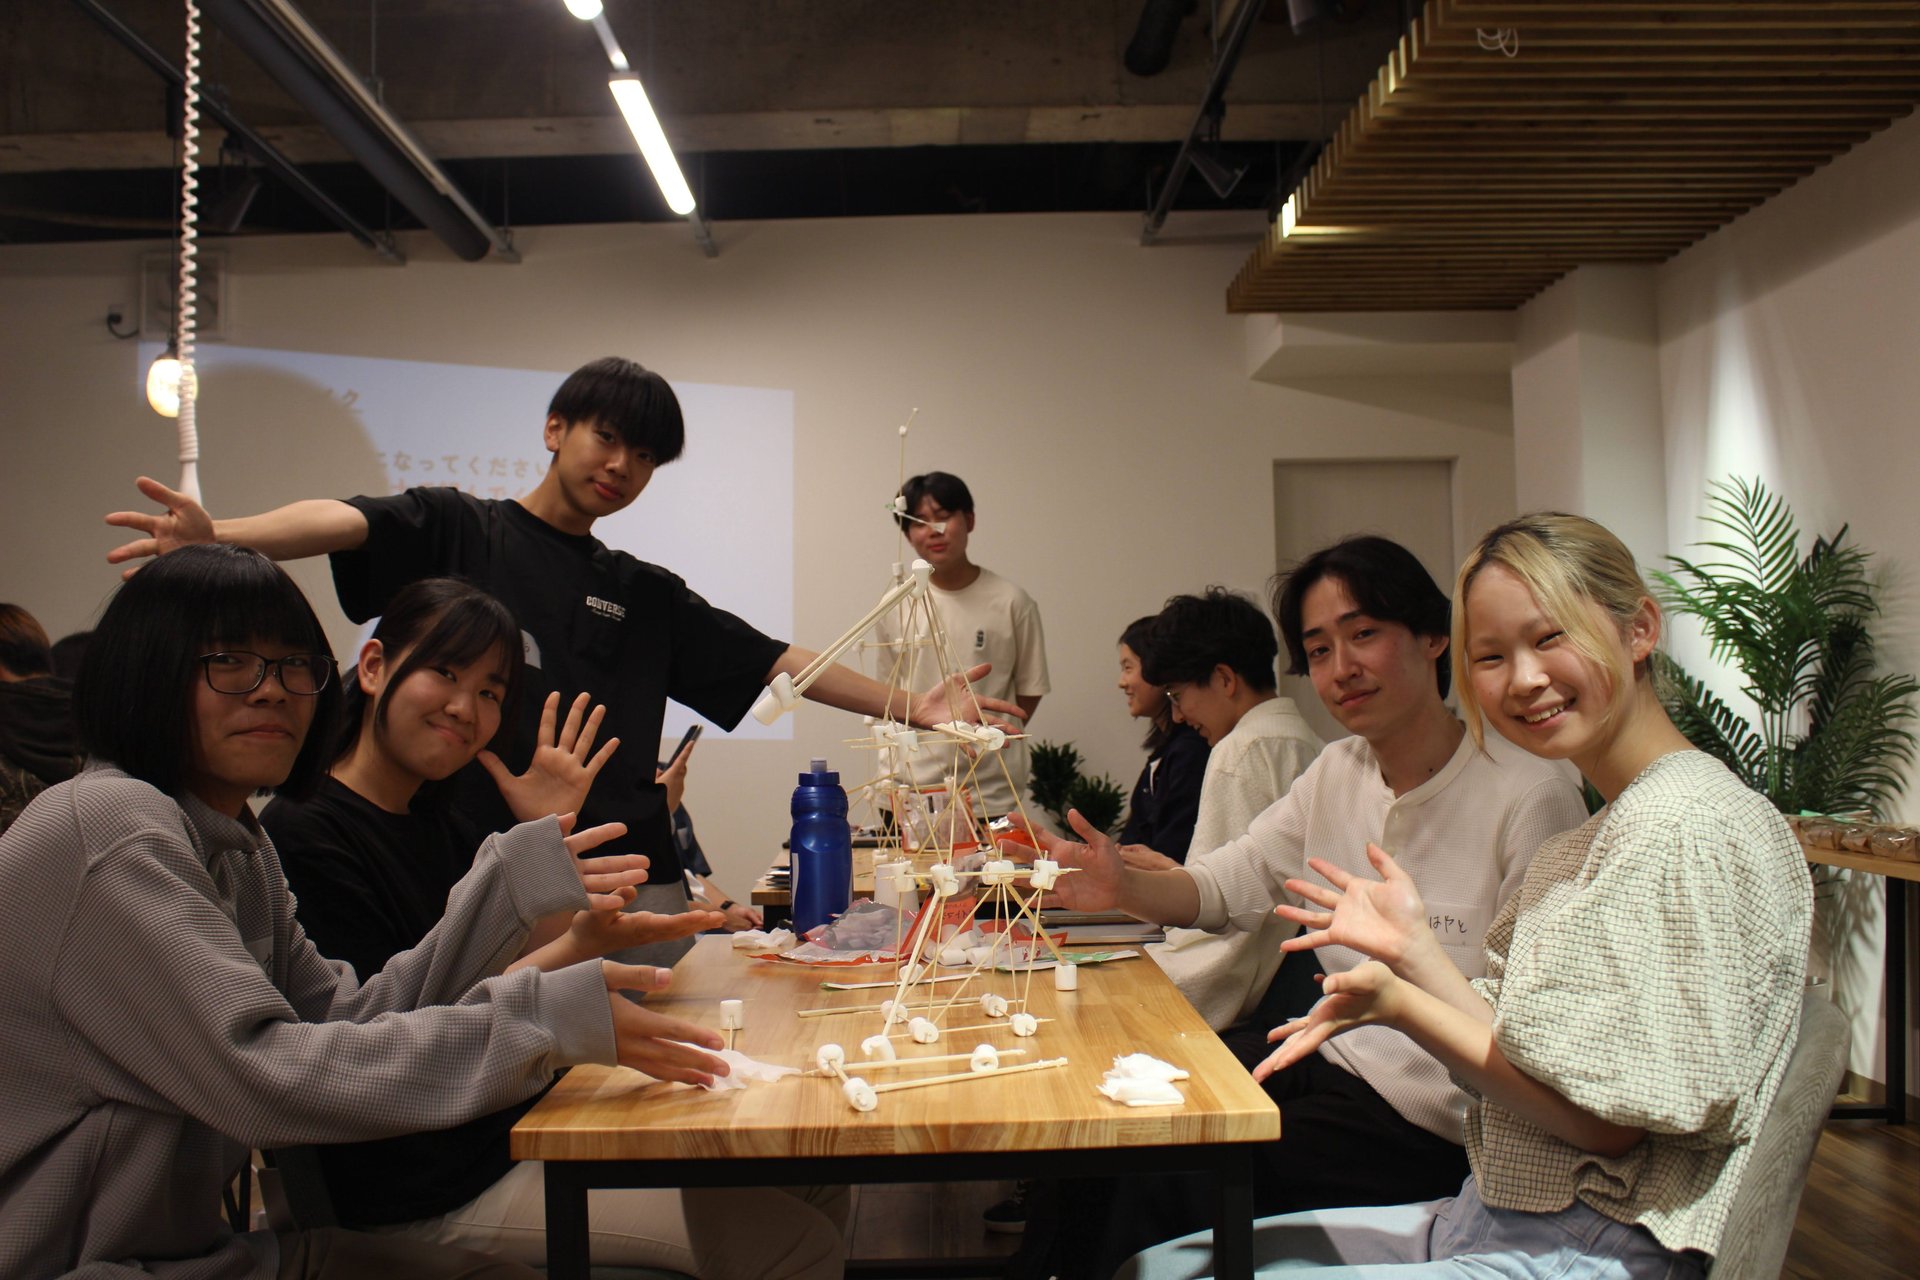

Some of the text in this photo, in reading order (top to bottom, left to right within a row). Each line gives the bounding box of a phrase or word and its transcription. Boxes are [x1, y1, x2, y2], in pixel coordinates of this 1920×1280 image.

[586, 595, 626, 618] CONVERSE
[1429, 914, 1468, 934] はやと
